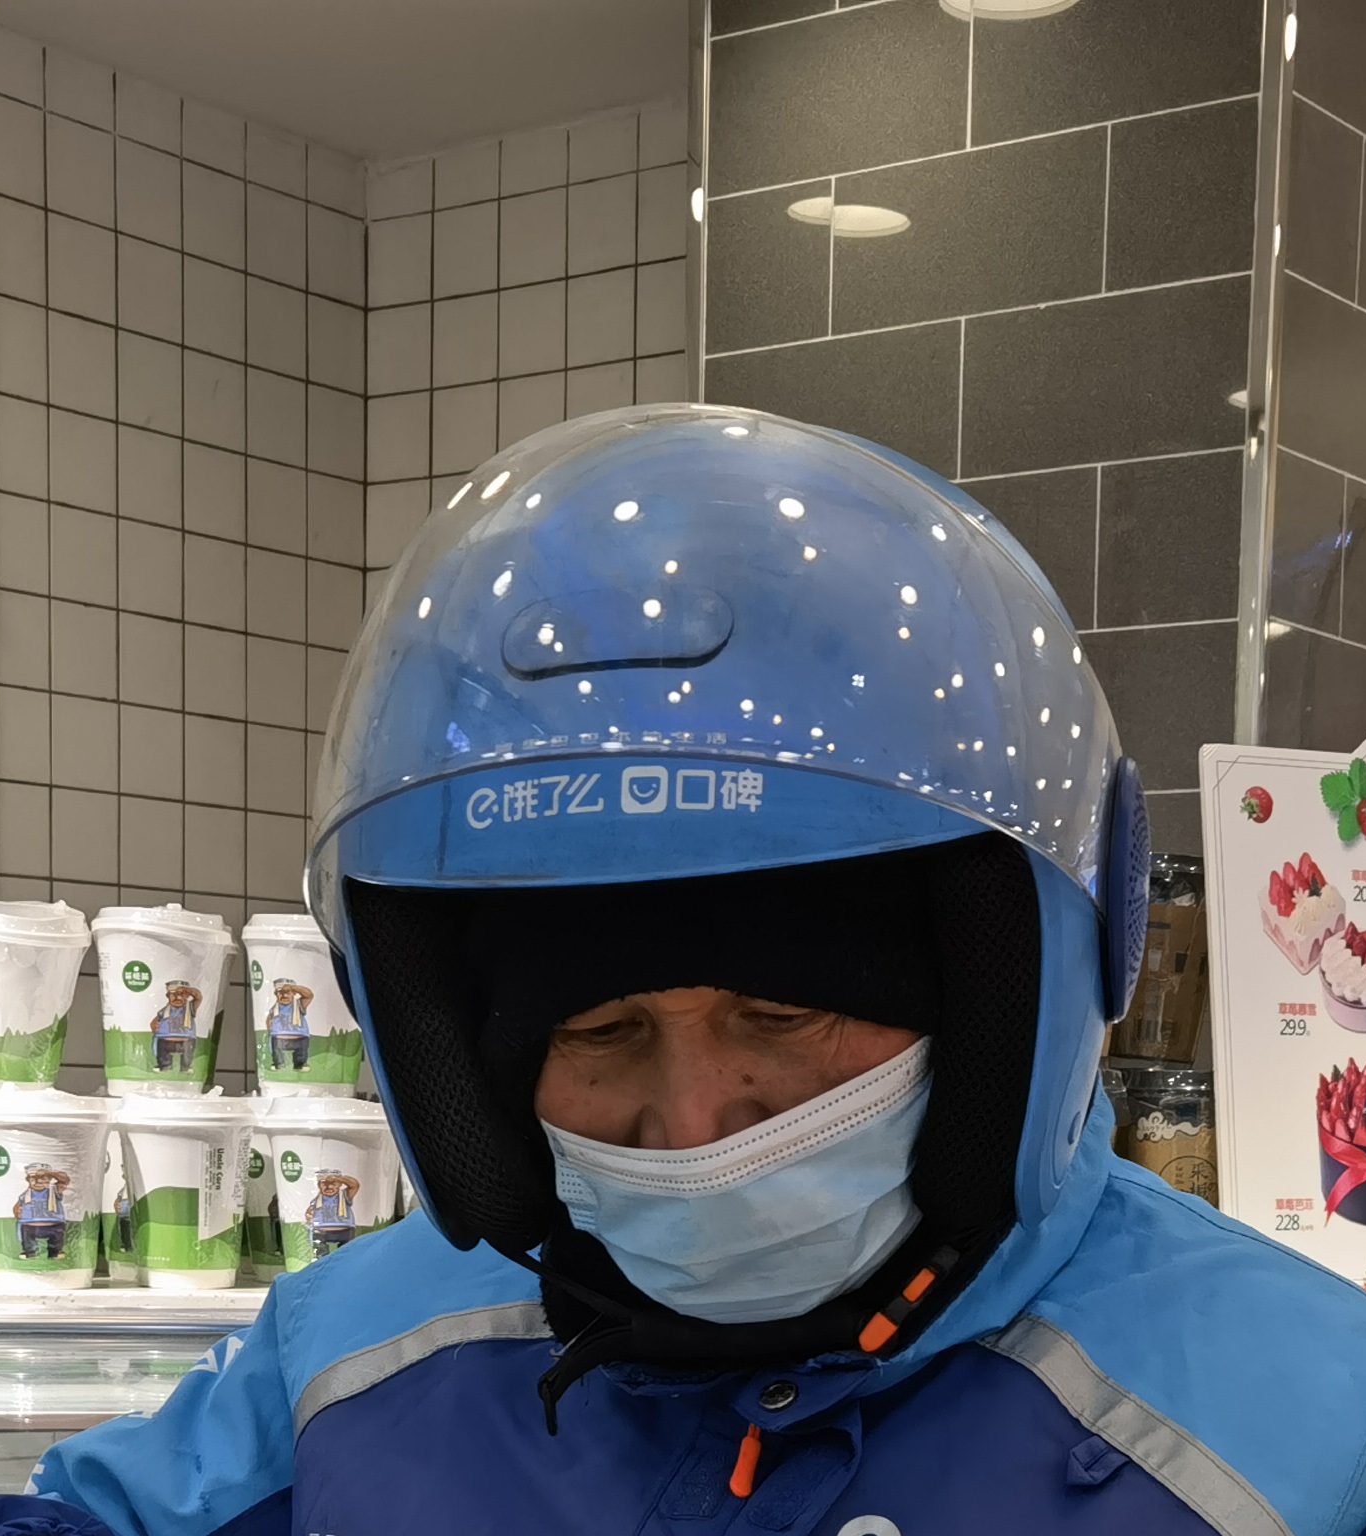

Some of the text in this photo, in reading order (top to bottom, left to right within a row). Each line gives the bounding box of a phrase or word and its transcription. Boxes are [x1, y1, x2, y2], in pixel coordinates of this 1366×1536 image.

[502, 772, 605, 824] 饿了么
[675, 768, 765, 814] 口碑
[1280, 1018, 1307, 1036] 29.9
[214, 1147, 225, 1191] Uncle Corn
[1275, 1213, 1300, 1231] 228
